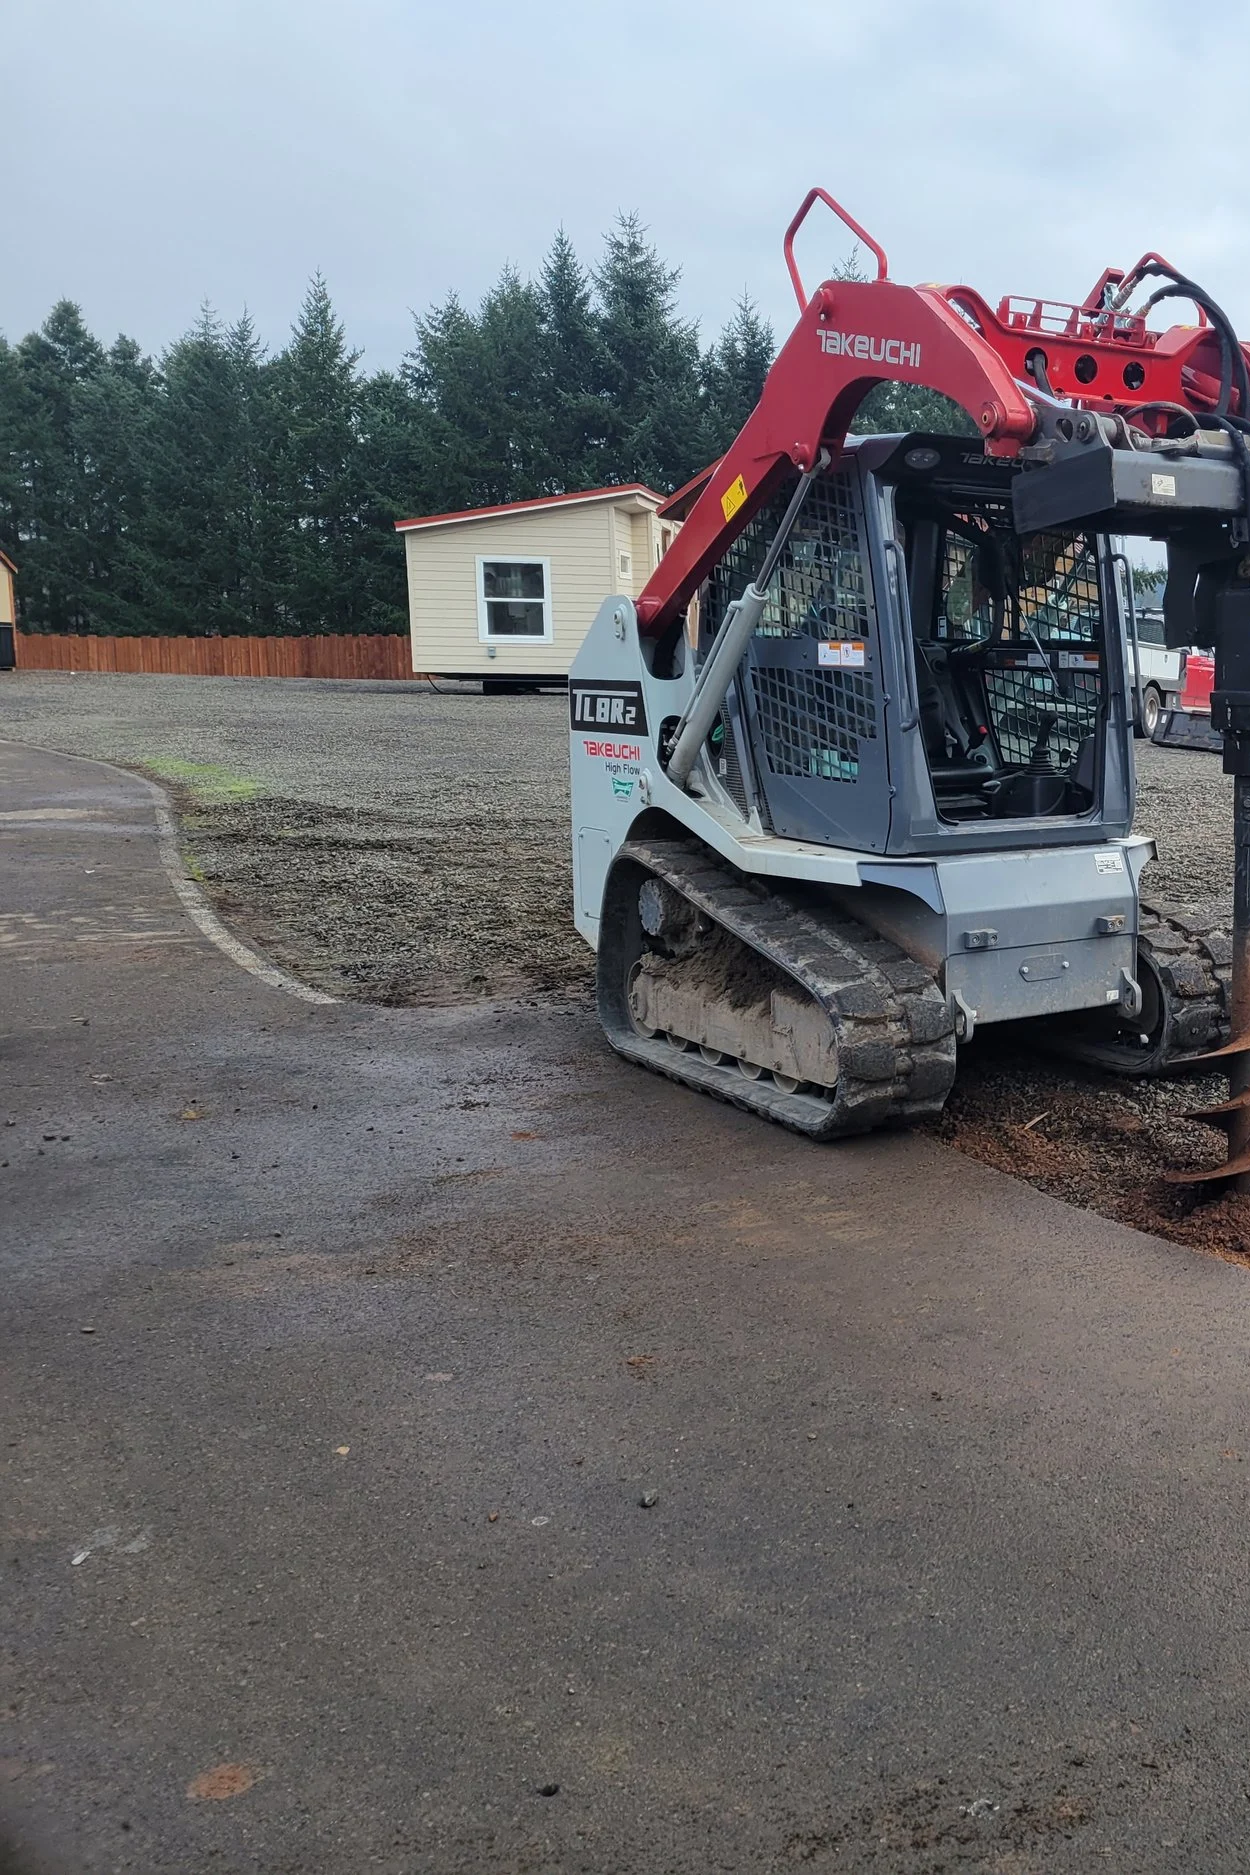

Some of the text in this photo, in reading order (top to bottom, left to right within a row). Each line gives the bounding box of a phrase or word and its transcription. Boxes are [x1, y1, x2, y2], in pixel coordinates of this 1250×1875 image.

[572, 688, 638, 725] TL8R2
[605, 762, 640, 775] High Flow
